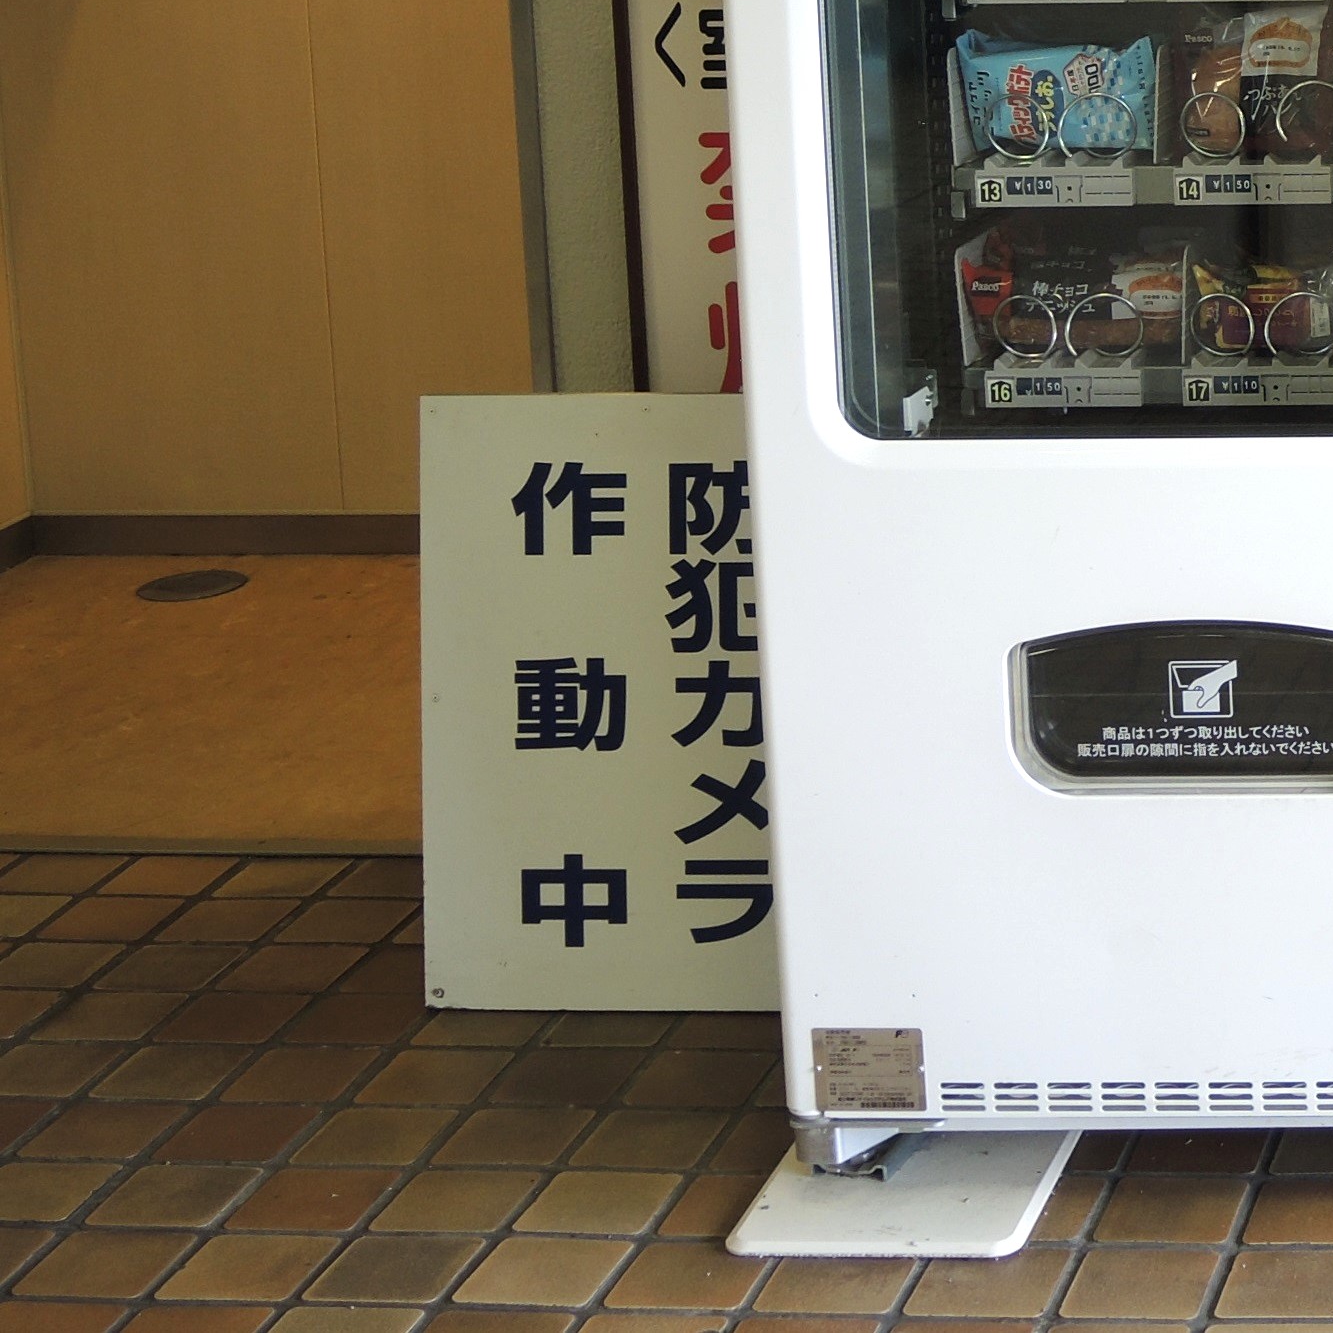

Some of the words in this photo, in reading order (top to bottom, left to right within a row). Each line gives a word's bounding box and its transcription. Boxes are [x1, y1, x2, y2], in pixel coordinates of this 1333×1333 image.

[1184, 34, 1213, 43] Pasco
[982, 181, 999, 200] 13
[1180, 180, 1198, 199] 14
[991, 381, 1009, 401] 16
[1189, 381, 1208, 400] 17
[665, 461, 774, 944] 防犯カメラ
[1102, 726, 1309, 739] 商品は1つずつ取り出してください
